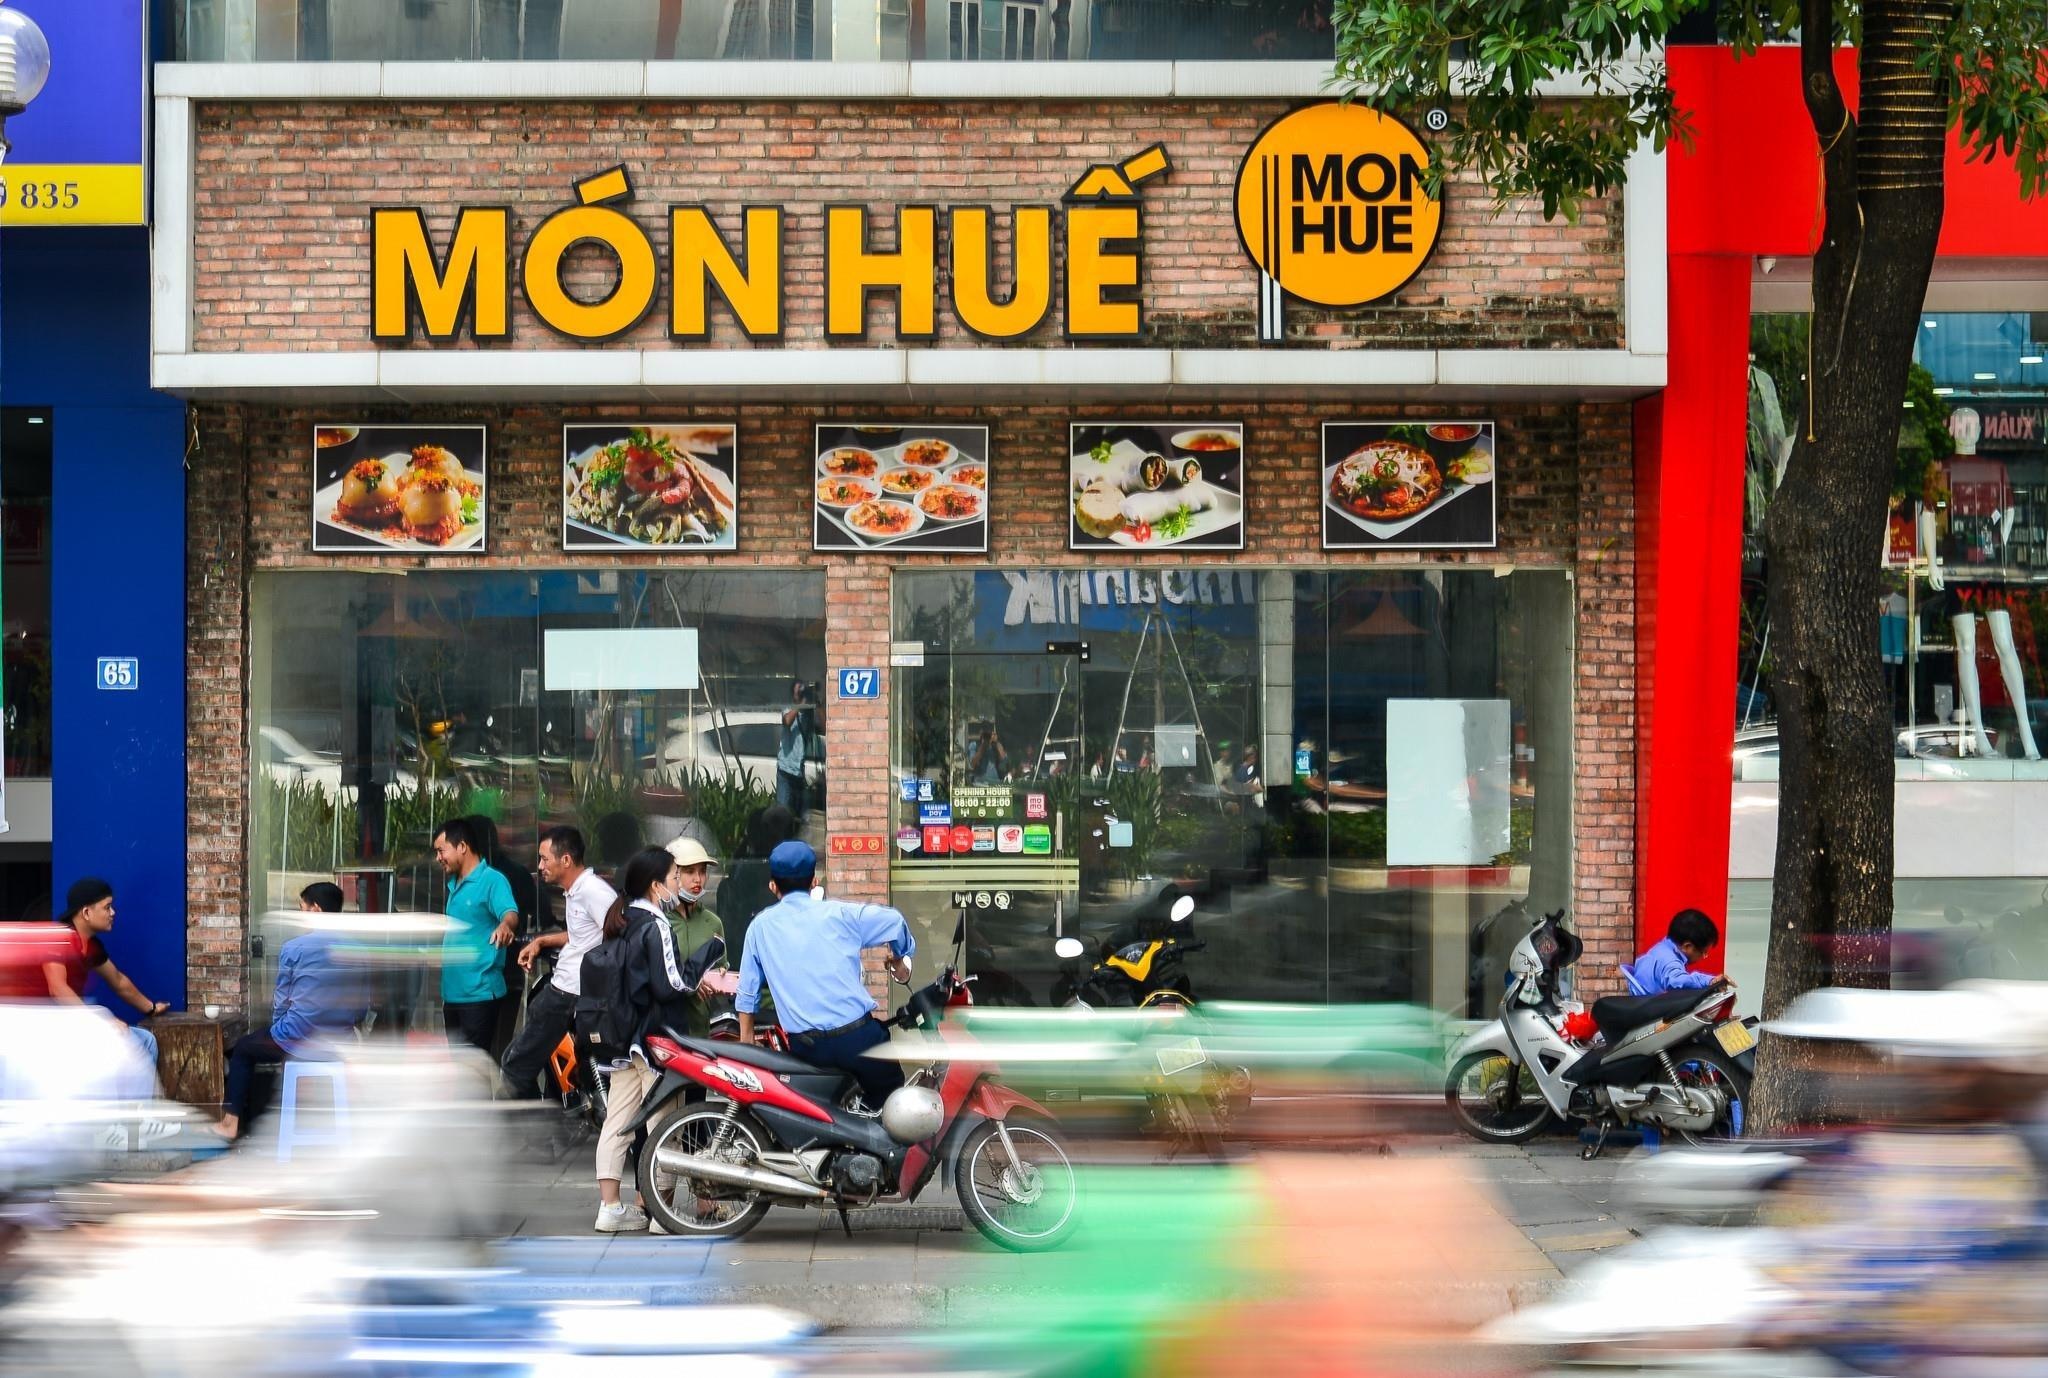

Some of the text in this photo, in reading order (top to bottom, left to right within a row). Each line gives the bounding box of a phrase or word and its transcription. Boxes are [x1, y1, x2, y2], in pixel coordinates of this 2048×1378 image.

[1292, 153, 1439, 203] MON
[21, 183, 79, 209] 835
[369, 141, 1173, 342] MÓN HUẾ
[1292, 205, 1413, 254] HUE
[104, 661, 131, 684] 65
[845, 671, 871, 694] 67
[954, 787, 1010, 796] OPENING HOURS
[954, 797, 979, 807] 08:00
[986, 797, 1011, 807] 22:00
